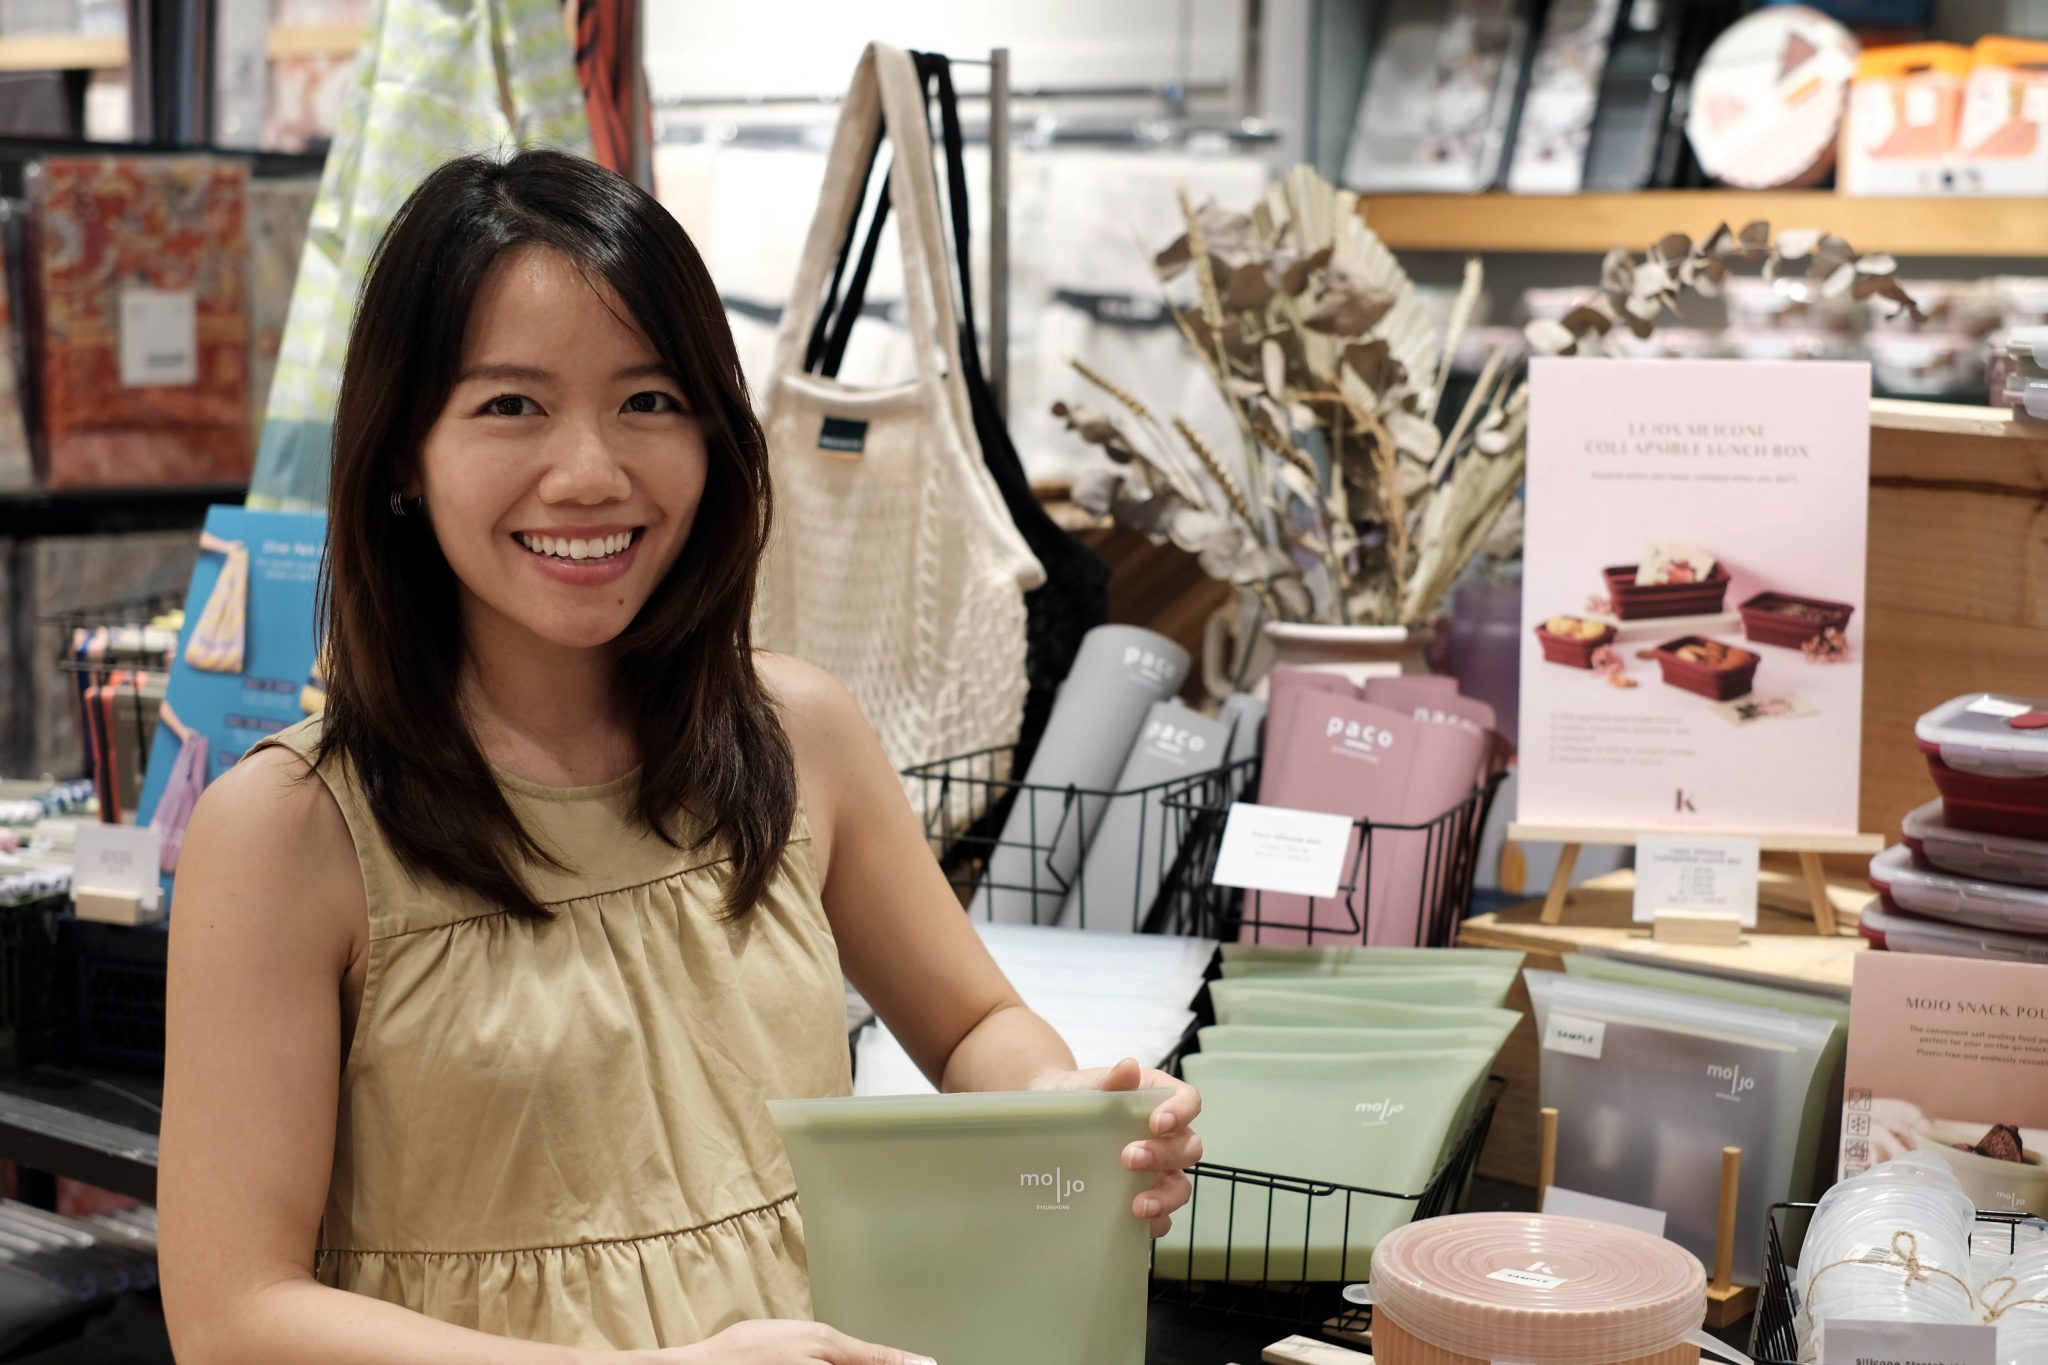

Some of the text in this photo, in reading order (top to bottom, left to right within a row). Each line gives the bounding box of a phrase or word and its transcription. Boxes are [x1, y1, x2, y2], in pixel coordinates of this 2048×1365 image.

[1687, 423, 1765, 438] SILICONE
[1584, 440, 1810, 459] COLLAPSIBLE LUNCH BOX
[1146, 720, 1205, 752] paco
[1326, 716, 1393, 748] paco
[1906, 997, 1951, 1011] MOJO
[1957, 1001, 2010, 1017] SNACK
[1557, 1029, 1593, 1044] SAMPLE
[1910, 1025, 1923, 1033] The
[1925, 1028, 1969, 1037] convenient
[2018, 1034, 2037, 1043] food
[1919, 1036, 1948, 1045] perfect
[1950, 1038, 1961, 1046] for
[1964, 1040, 1981, 1048] your
[1963, 1053, 1978, 1061] and
[1980, 1055, 2016, 1065] endlessly
[1507, 1273, 1548, 1284] SAMPLE
